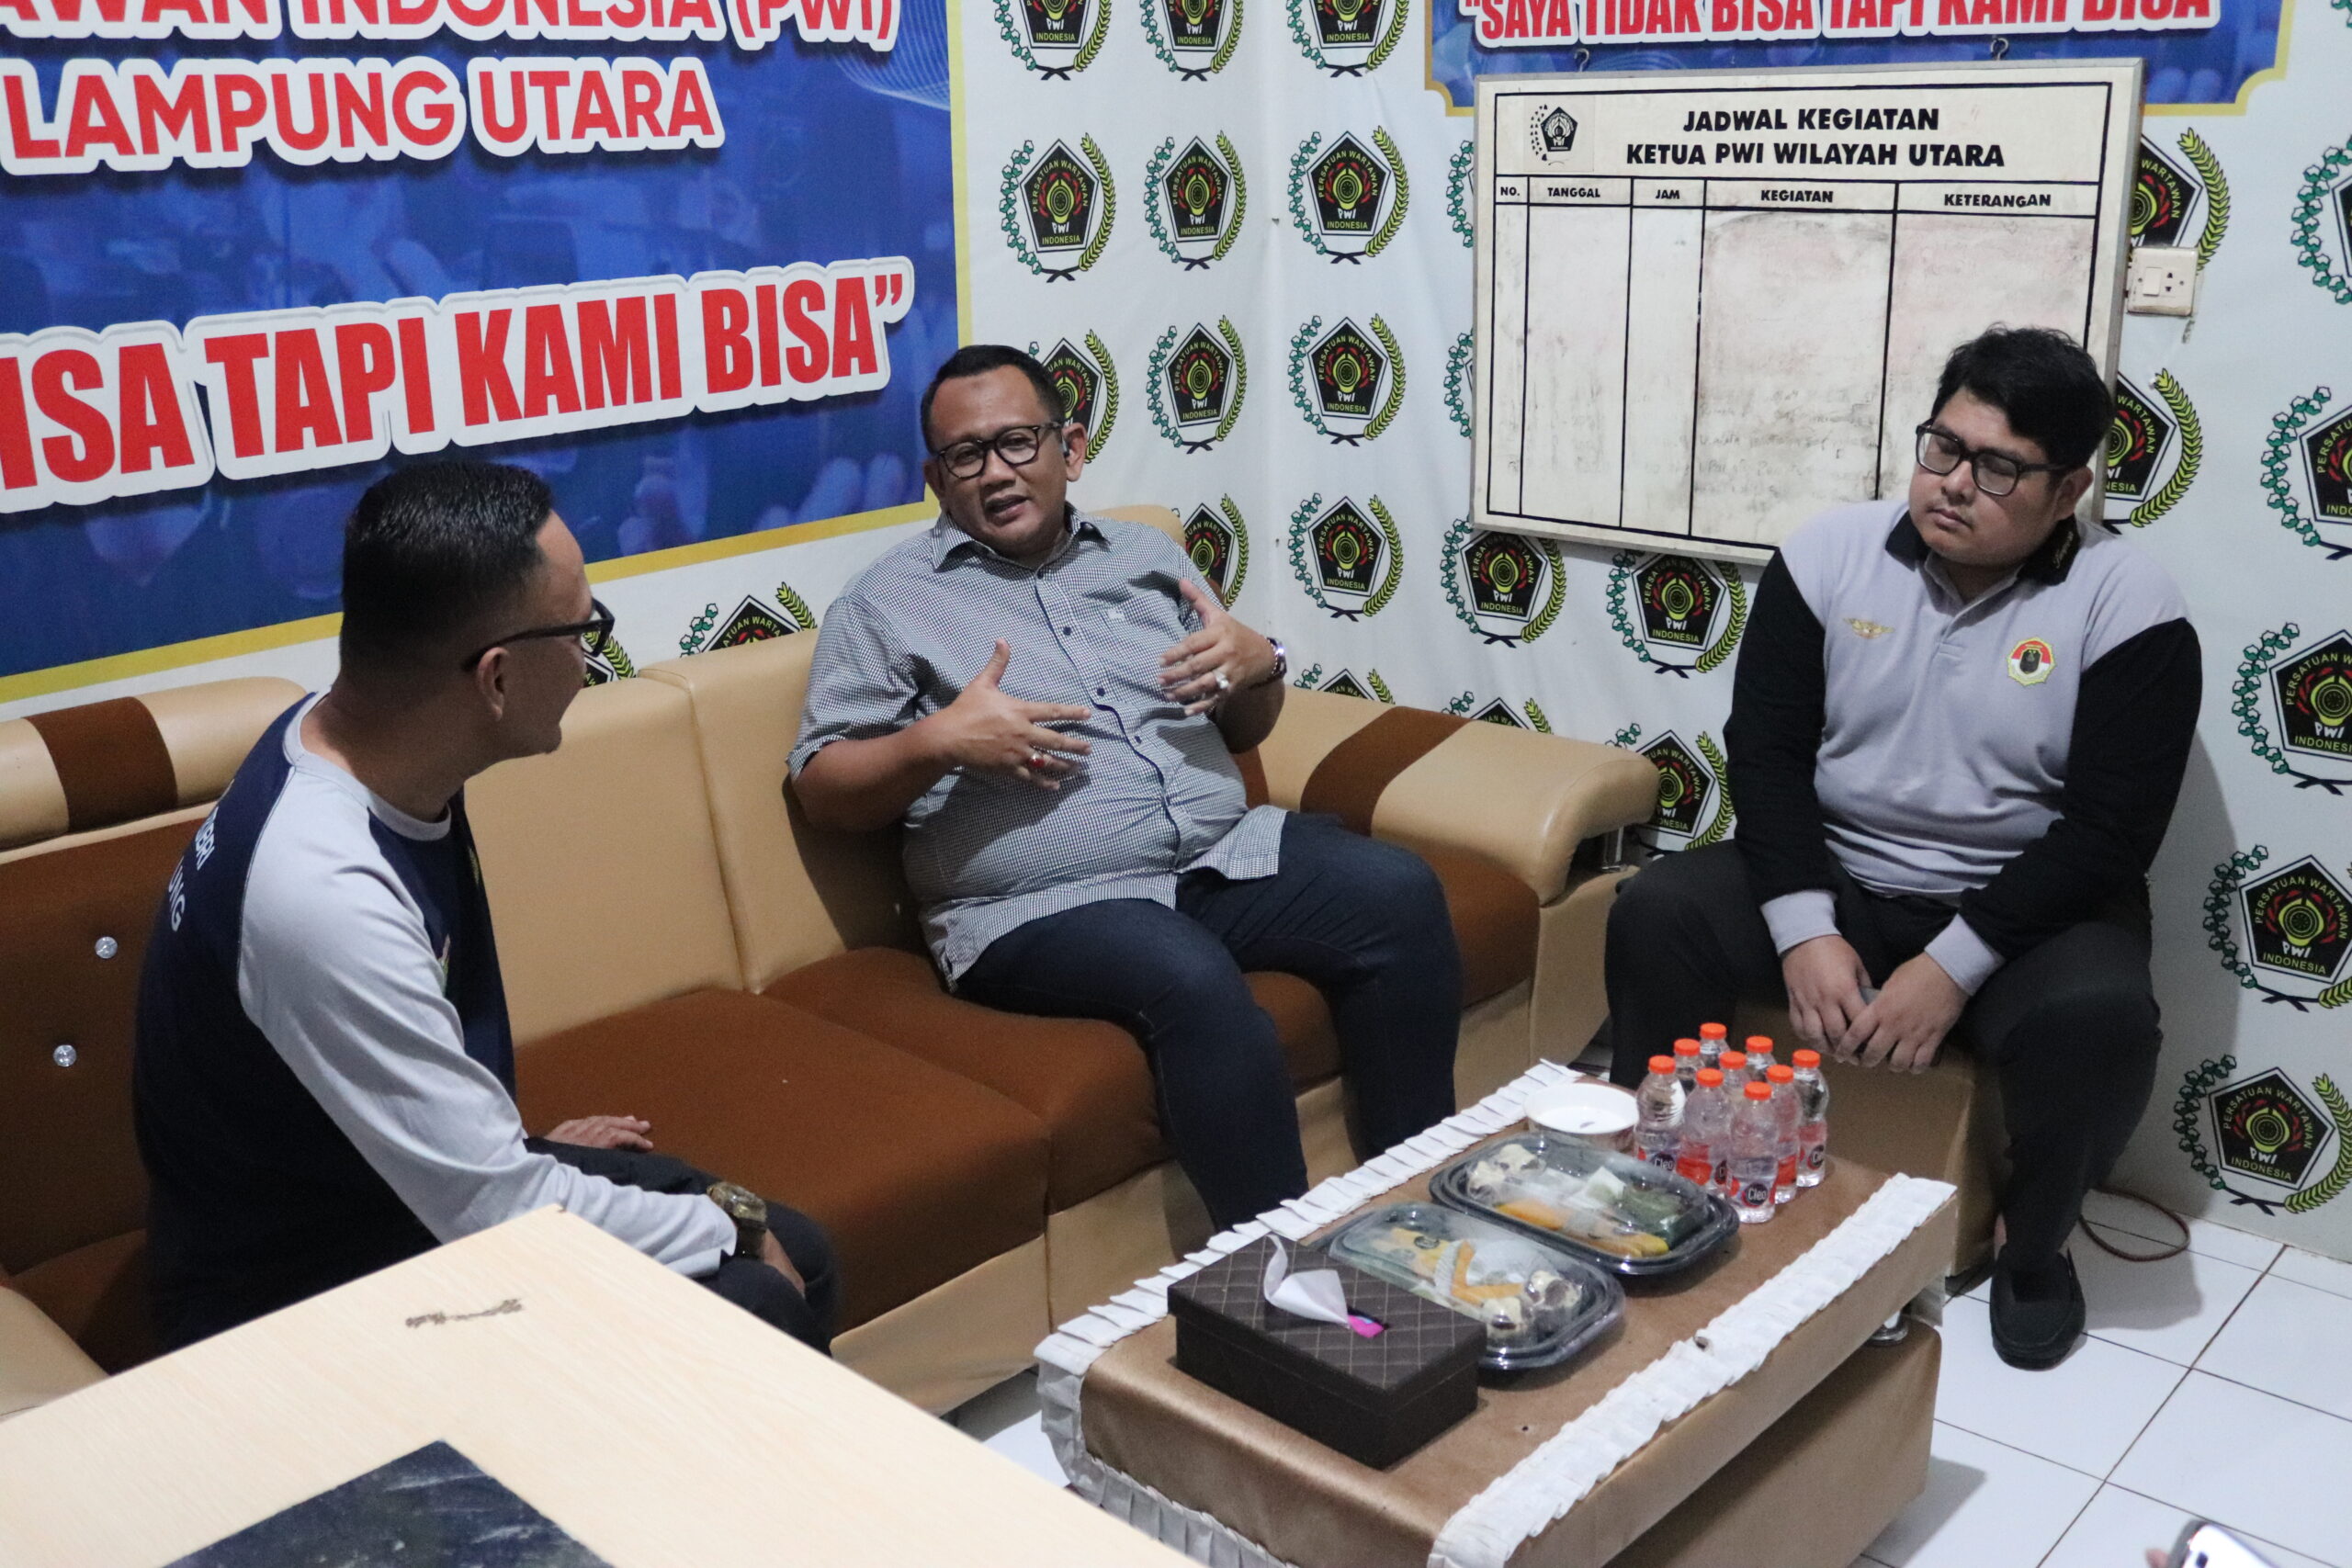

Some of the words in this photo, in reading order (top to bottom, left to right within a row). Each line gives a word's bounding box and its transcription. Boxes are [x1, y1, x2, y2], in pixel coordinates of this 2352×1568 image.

[1046, 18, 1064, 30] PWI
[1186, 22, 1203, 35] PWI
[1338, 18, 1358, 31] PWI
[1036, 32, 1075, 41] INDONESIA
[1327, 33, 1371, 42] INDONESIA
[3, 70, 455, 159] LAMPUNG
[479, 69, 716, 144] UTARA
[1682, 108, 1788, 132] JADWAL
[1797, 107, 1939, 130] KEGIATAN
[1626, 143, 1707, 164] KETUA
[1715, 142, 1764, 164] PWI
[1773, 142, 1897, 165] WILAYAH
[1908, 143, 2005, 167] UTARA
[1172, 156, 1196, 206] PERSATUAN
[1197, 155, 1222, 201] WARTAWAN
[1317, 151, 1347, 198] PERSATUAN
[1349, 151, 1378, 197] WARTAWAN
[1033, 160, 1058, 213] PERSATUAN
[1060, 160, 1089, 208] WARTAWAN
[1499, 186, 1521, 197] NO.
[1547, 186, 1601, 198] TANGGAL
[2141, 160, 2181, 219] WARTAWAN
[1655, 189, 1680, 200] JAM
[1759, 189, 1834, 203] KEGIATAN
[1943, 194, 2052, 208] KETERANGAN
[1189, 213, 1205, 225] PWI
[1338, 208, 1356, 219] PWI
[1052, 221, 1069, 234] PWI
[1181, 226, 1216, 235] INDONESIA
[1327, 220, 1368, 230] INDONESIA
[1042, 235, 1081, 245] INDONESIA
[1319, 335, 1346, 380] PERSATUAN
[1348, 335, 1376, 381] WARTAWAN
[1174, 341, 1198, 391] PERSATUAN
[1200, 341, 1225, 383] WARTAWAN
[204, 316, 435, 458] TAPI
[455, 293, 683, 426] KAMI
[1066, 357, 1091, 401] WARTAWAN
[1337, 390, 1356, 402] PWI
[1191, 397, 1207, 410] PWI
[1327, 403, 1367, 413] INDONESIA
[1182, 409, 1218, 420] INDONESIA
[2117, 394, 2156, 454] WARTAWAN
[1319, 514, 1346, 556] PERSATUAN
[1348, 514, 1374, 560] WARTAWAN
[1337, 569, 1355, 579] PWI
[1327, 577, 1366, 590] INDONESIA
[1493, 590, 1512, 603] PWI
[1481, 602, 1523, 615] INDONESIA
[1665, 616, 1688, 630] PWI
[1652, 629, 1700, 643] INDONESIA
[2286, 653, 2338, 705] PERSATUAN
[2314, 721, 2345, 739] PWI
[2255, 876, 2305, 924] PERSATUAN
[2310, 878, 2348, 939] WARTAWAN
[2282, 941, 2312, 958] PWI
[2263, 952, 2326, 975] INDONESIA
[2223, 1088, 2272, 1130] PERSATUAN
[2277, 1089, 2313, 1148] WARTAWAN
[2249, 1146, 2278, 1165] PWI
[1654, 1158, 1674, 1170] Cleo
[2231, 1156, 2292, 1181] INDONESIA
[1747, 1189, 1768, 1201] Cleo
